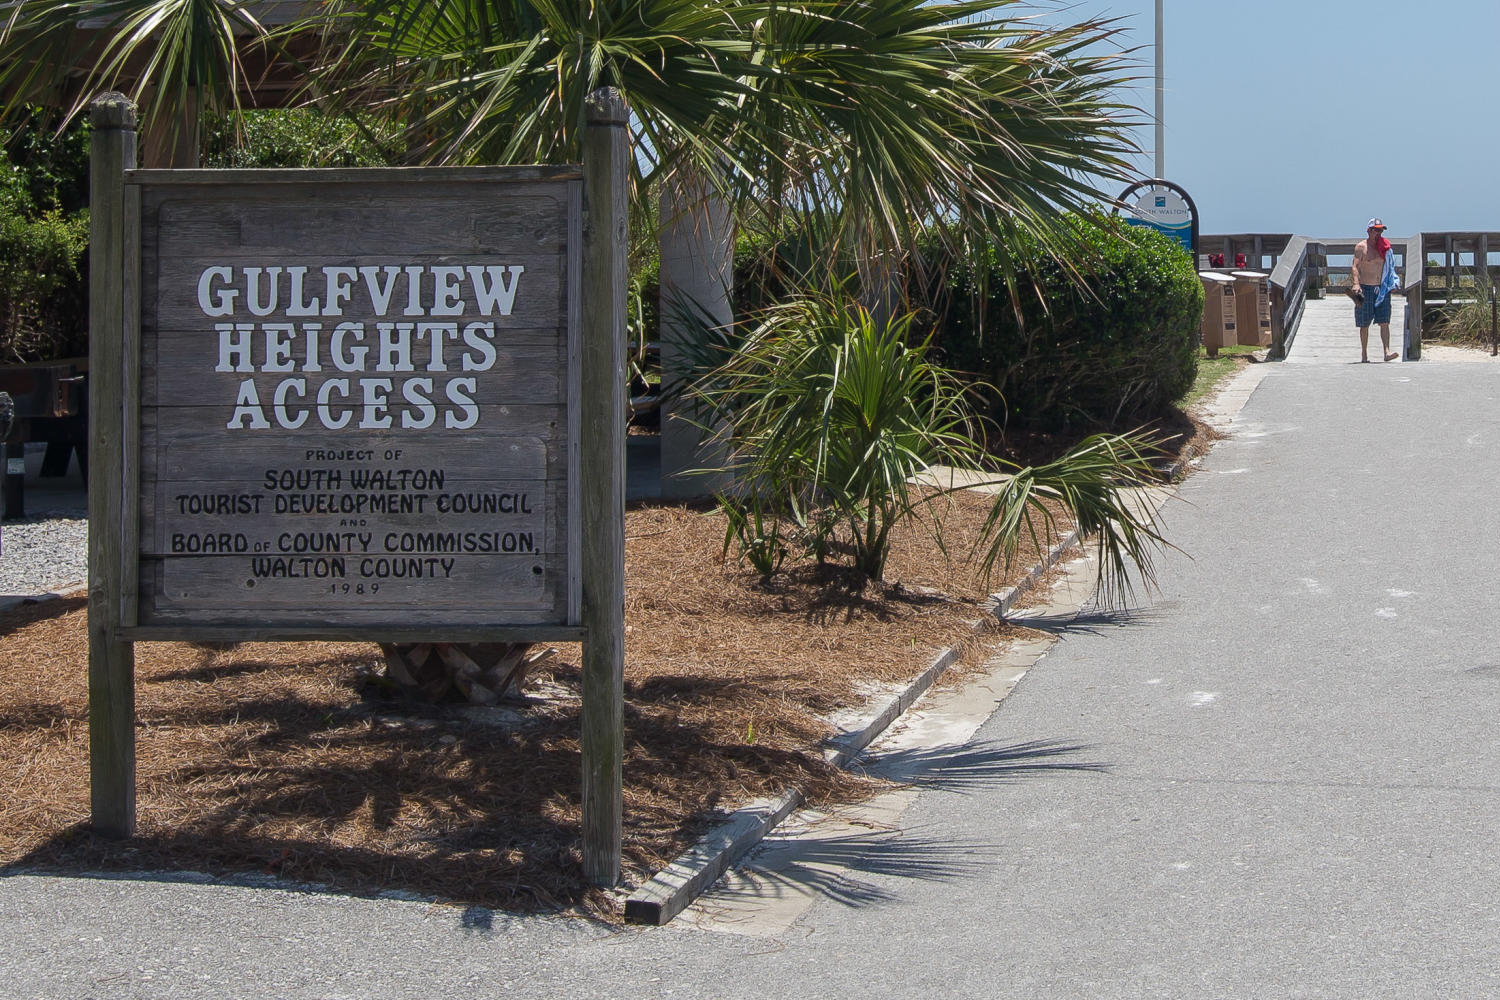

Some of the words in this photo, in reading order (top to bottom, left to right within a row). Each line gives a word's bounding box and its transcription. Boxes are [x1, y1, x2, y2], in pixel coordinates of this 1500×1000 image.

[197, 265, 525, 317] GULFVIEW
[215, 322, 498, 372] HEIGHTS
[226, 377, 480, 430] ACCESS
[305, 450, 374, 461] PROJECT
[384, 450, 403, 461] OF
[263, 469, 342, 490] SOUTH
[350, 469, 445, 491] WALTON
[176, 494, 264, 515] TOURIST
[274, 494, 428, 515] DEVELOPMENT
[436, 494, 532, 515] COUNCIL
[339, 519, 367, 527] AND
[172, 533, 248, 553] BOARD
[253, 543, 270, 552] OF
[277, 533, 372, 553] COUNTY
[383, 533, 540, 556] COMMISSION,
[252, 558, 346, 578] WALTON
[360, 558, 455, 578] COUNTY
[330, 584, 380, 595] 1989
